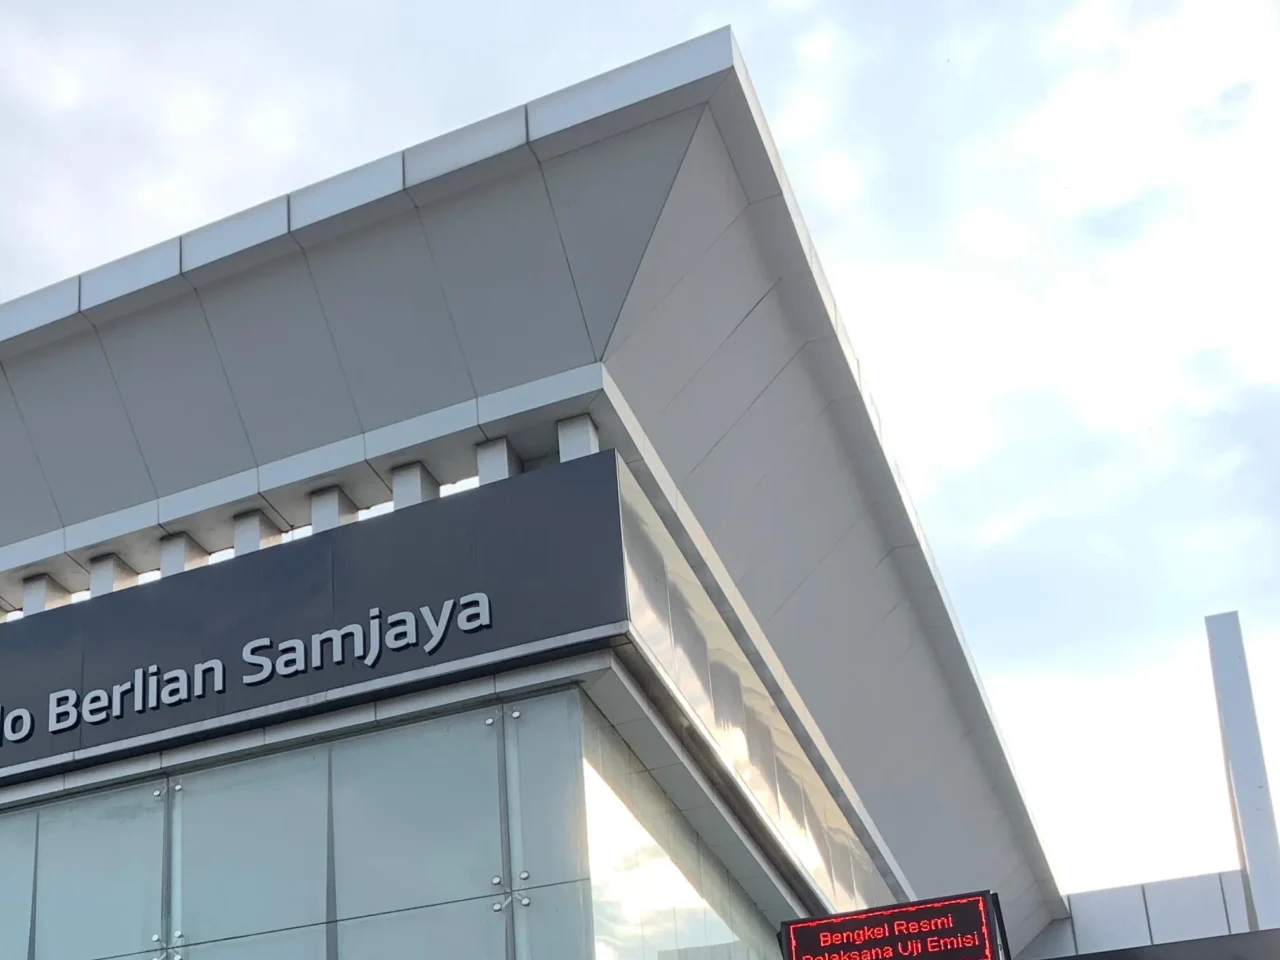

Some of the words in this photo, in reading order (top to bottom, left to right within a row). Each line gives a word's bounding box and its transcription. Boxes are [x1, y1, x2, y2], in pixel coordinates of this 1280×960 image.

[47, 656, 225, 733] Berlian
[241, 590, 493, 686] Samjaya
[819, 925, 889, 947] Bengkel
[894, 913, 954, 936] Resmi
[898, 941, 922, 957] Uji
[926, 931, 980, 951] Emisi
